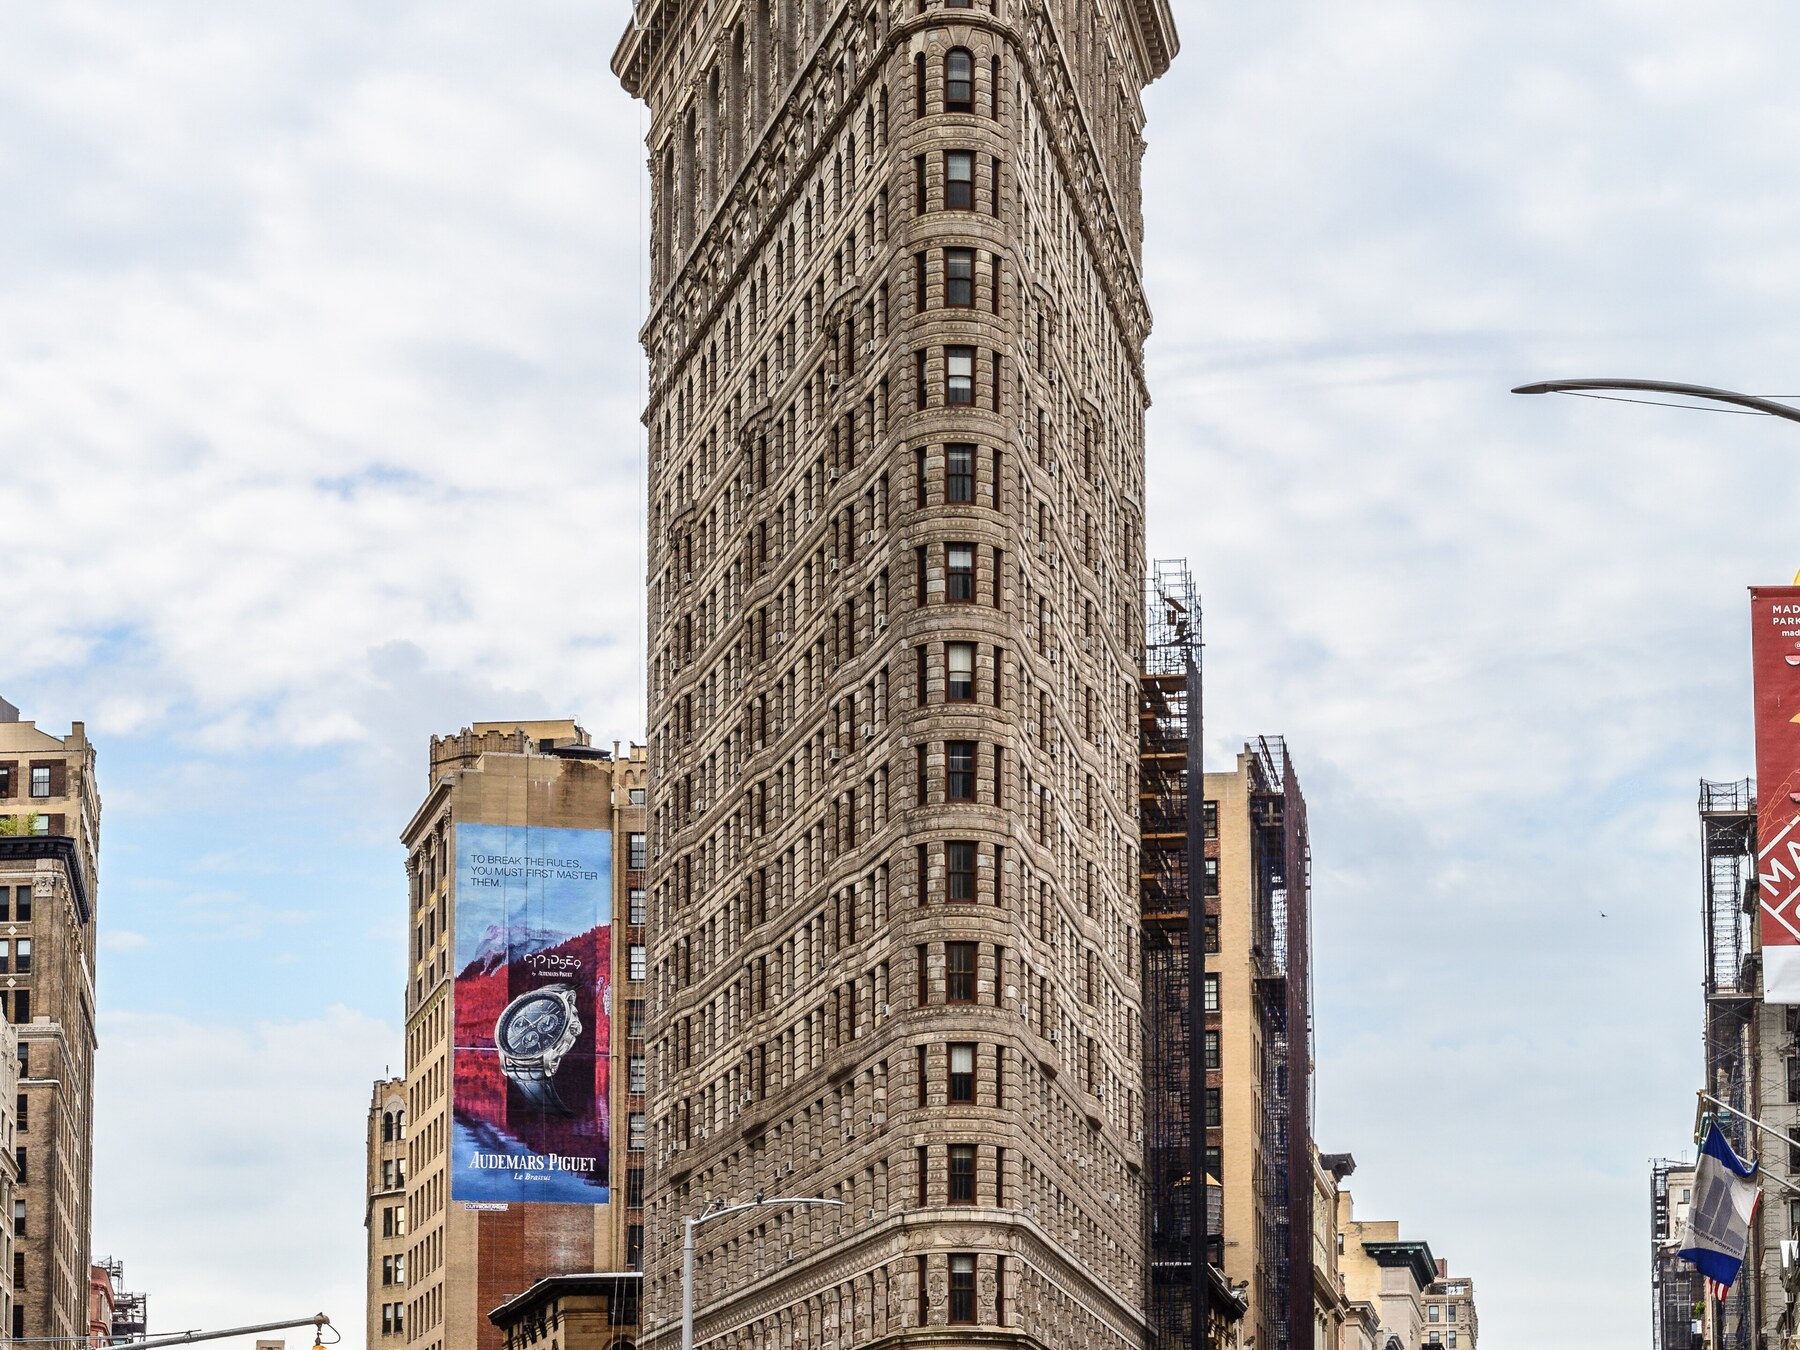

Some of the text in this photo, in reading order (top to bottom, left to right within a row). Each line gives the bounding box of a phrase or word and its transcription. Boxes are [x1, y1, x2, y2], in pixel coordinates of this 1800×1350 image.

[1773, 605, 1800, 614] MAD
[471, 854, 582, 869] TO BREAK THE RULES,
[471, 866, 598, 880] YOU MUST FIRST MASTER
[471, 877, 501, 887] THEM.
[469, 1151, 597, 1172] AUDEMARS PIGUET
[514, 1173, 551, 1181] Le Brassus
[1714, 1240, 1741, 1257] COMPANY
